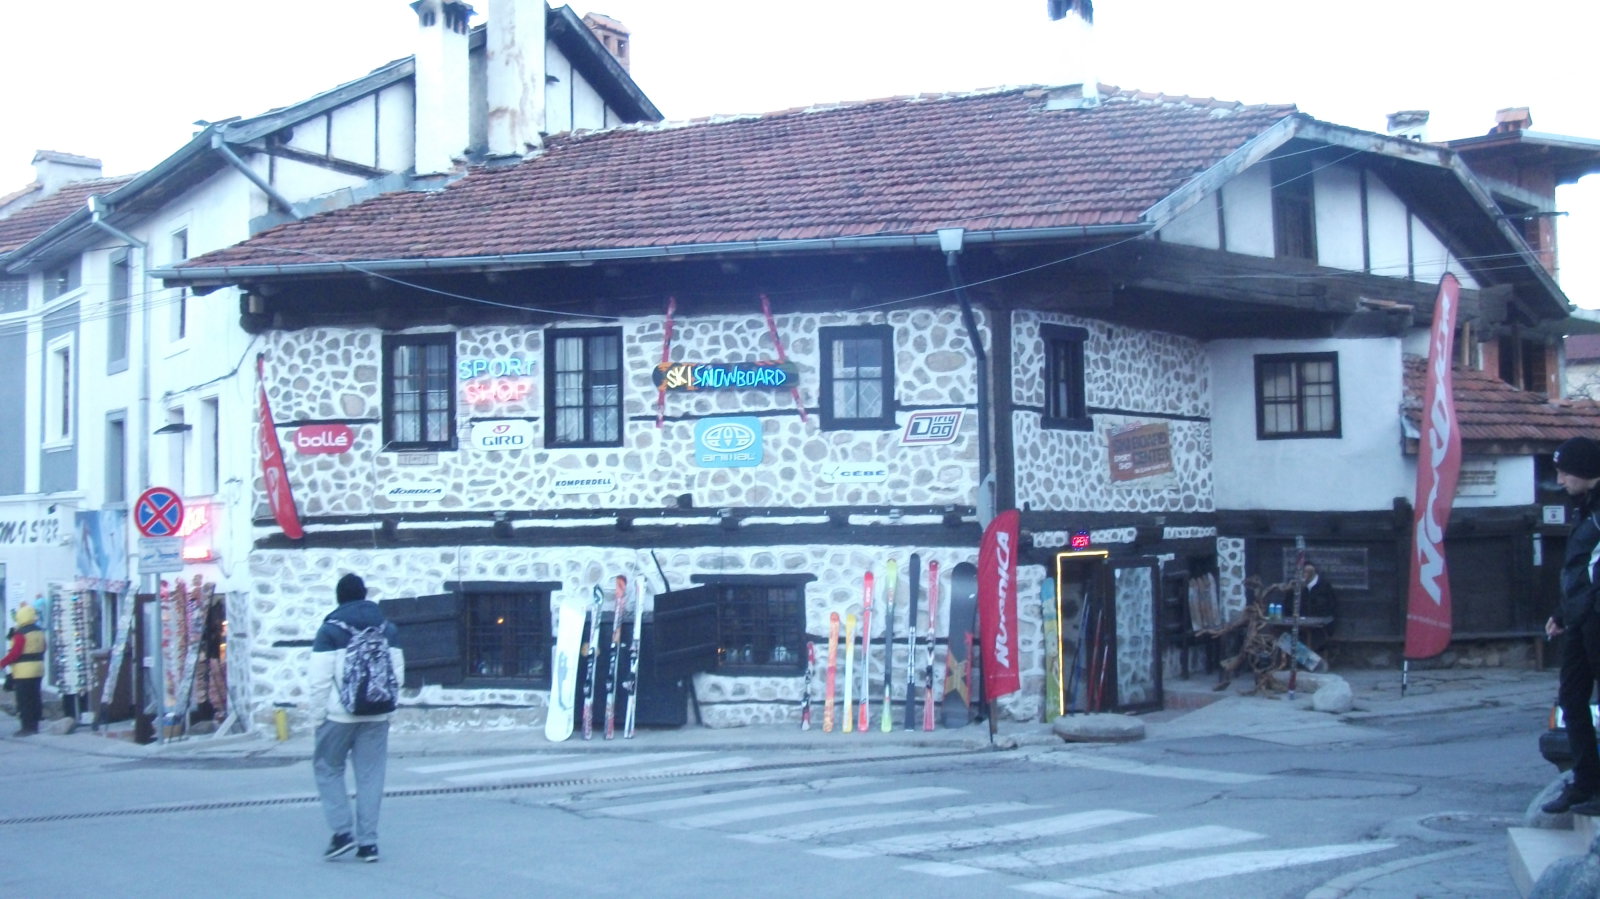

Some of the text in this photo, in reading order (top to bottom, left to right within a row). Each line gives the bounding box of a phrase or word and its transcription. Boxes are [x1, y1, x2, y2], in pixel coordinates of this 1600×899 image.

[459, 358, 536, 379] SPORT
[666, 364, 786, 388] SKI SNOWBOARD
[465, 380, 530, 404] SHOP
[298, 432, 348, 447] bollé
[482, 435, 523, 446] GIRO
[555, 478, 611, 487] KOMPERDELL
